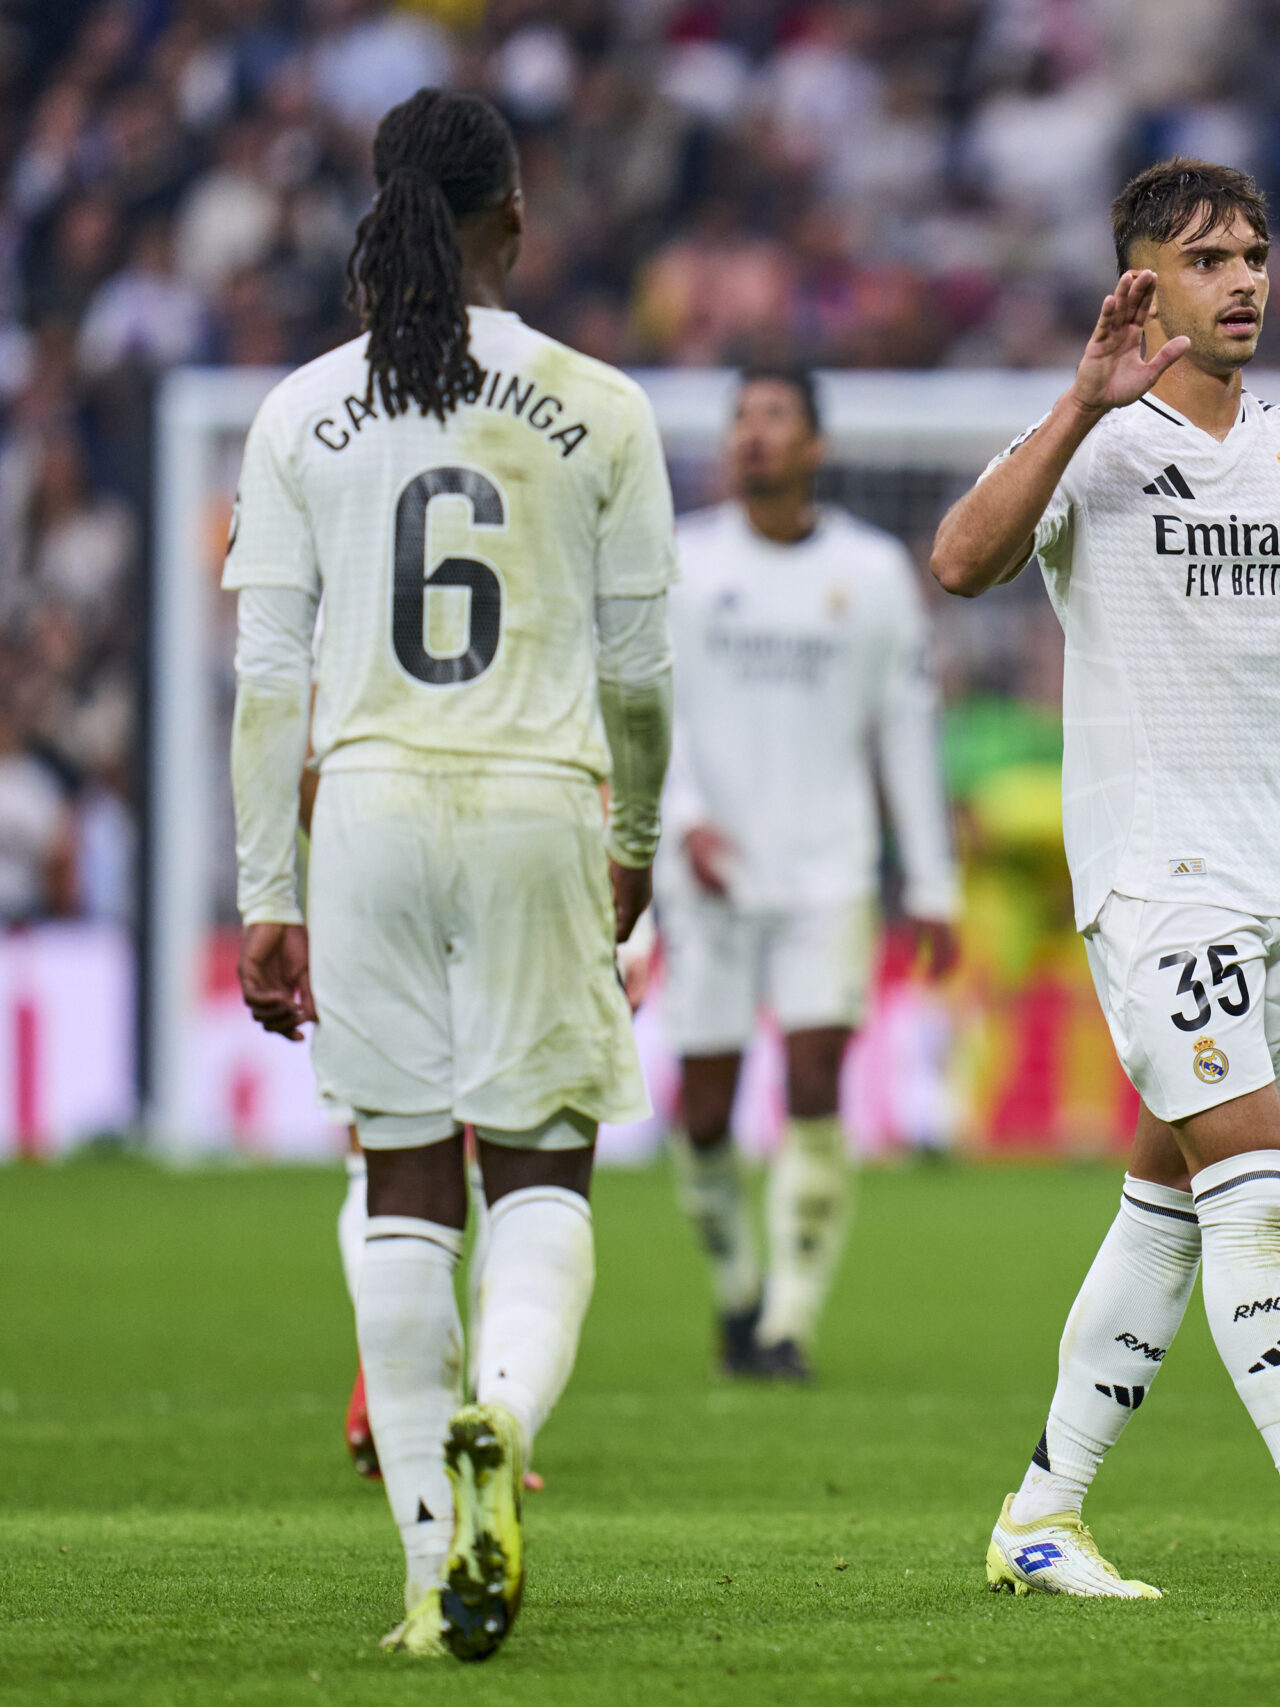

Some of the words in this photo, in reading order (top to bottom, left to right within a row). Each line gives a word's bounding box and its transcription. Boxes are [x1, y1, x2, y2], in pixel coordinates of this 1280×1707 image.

[314, 370, 588, 458] CAINGA
[391, 466, 505, 686] 6
[1185, 562, 1222, 598] FLY
[1157, 943, 1251, 1033] 35
[1114, 1332, 1167, 1362] RMC
